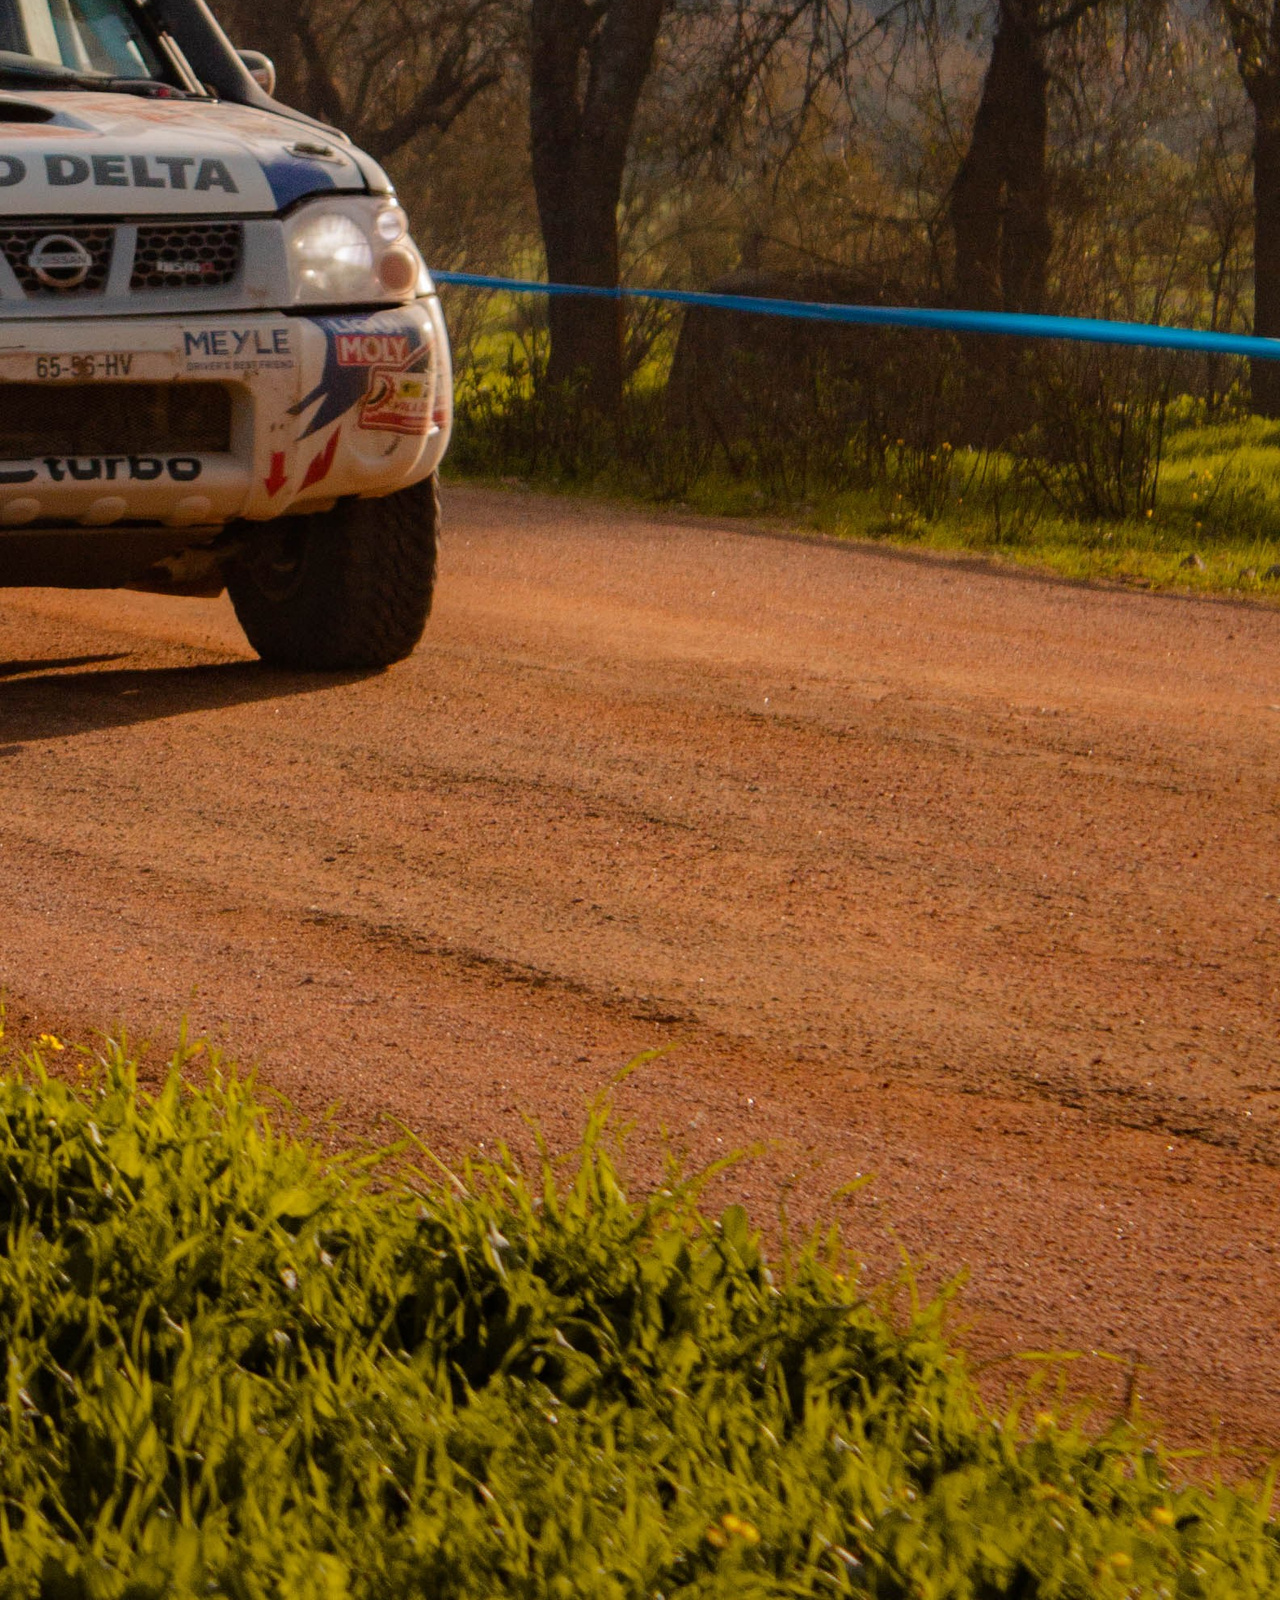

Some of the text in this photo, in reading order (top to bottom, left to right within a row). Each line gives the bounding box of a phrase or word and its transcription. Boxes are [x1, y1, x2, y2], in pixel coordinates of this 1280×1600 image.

[43, 153, 240, 194] DELTA
[183, 328, 291, 357] MEYLE
[340, 336, 408, 362] MOLY
